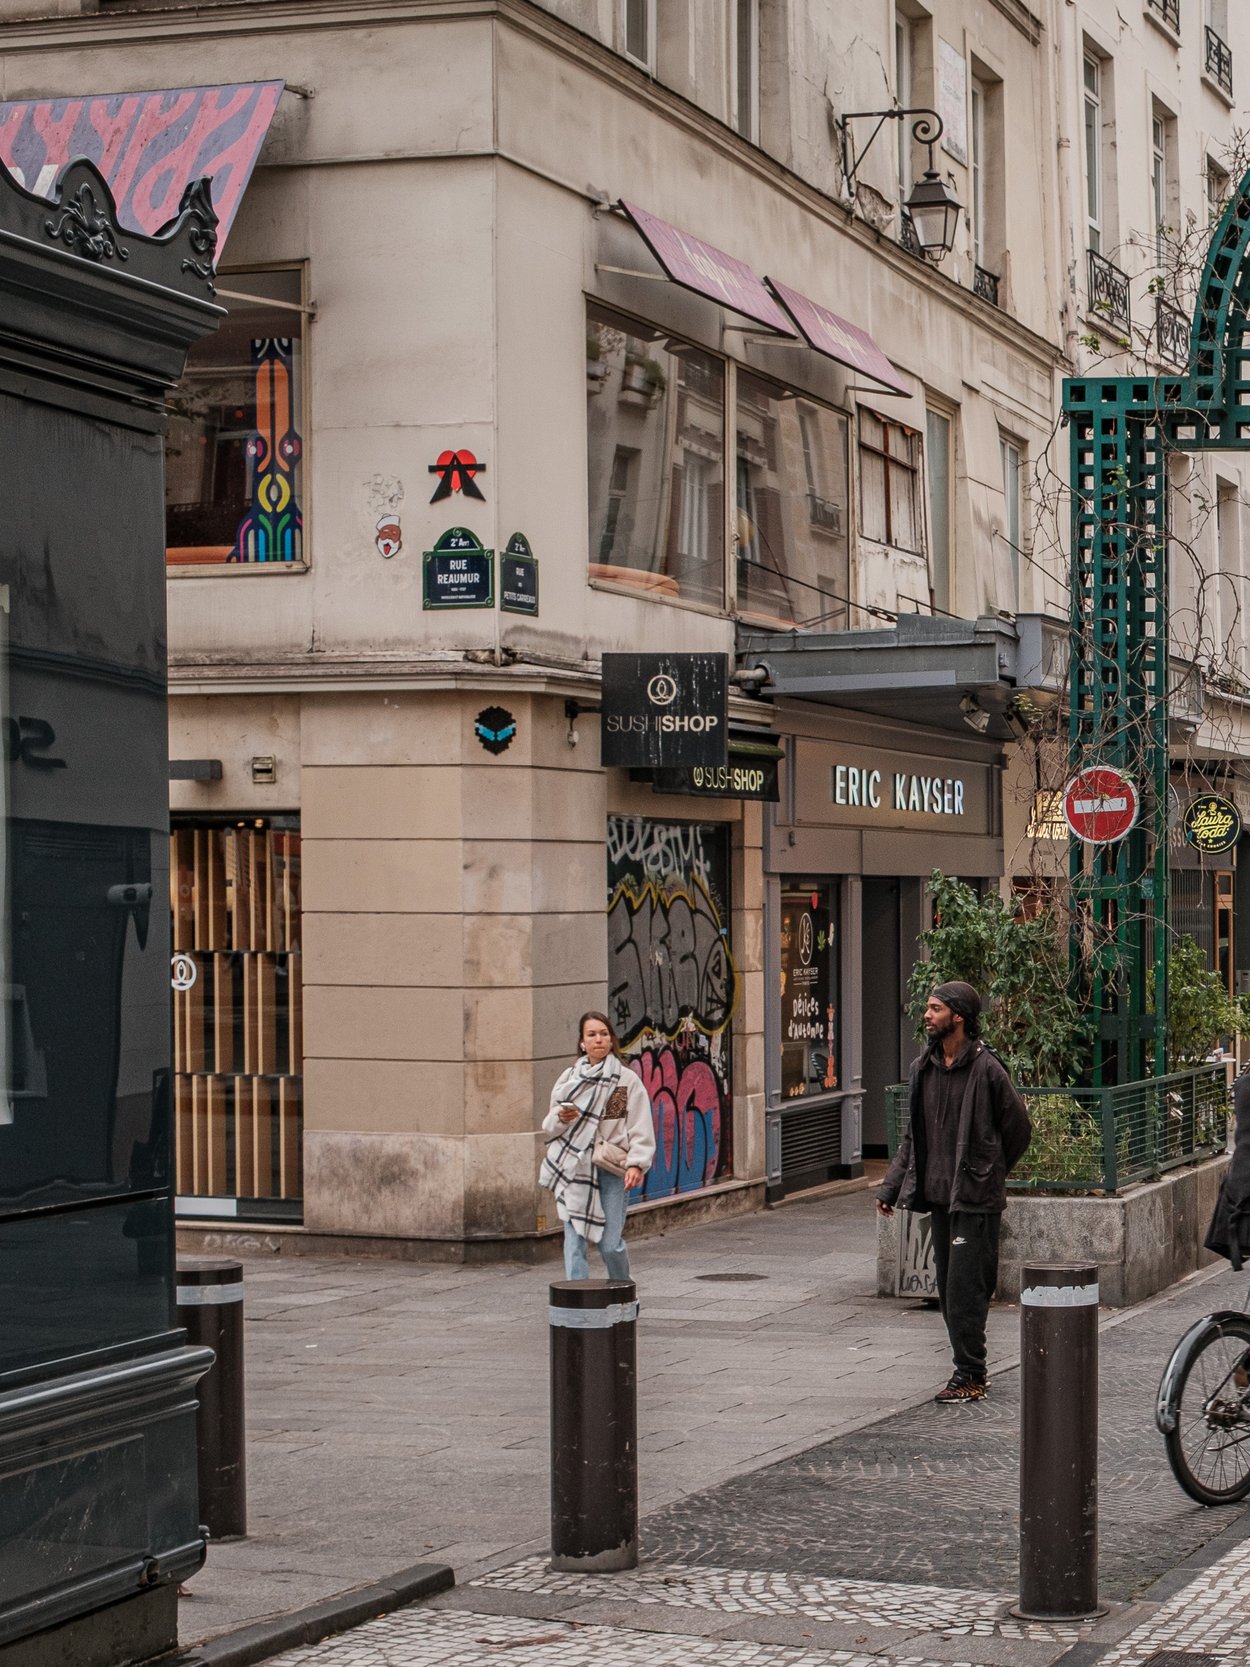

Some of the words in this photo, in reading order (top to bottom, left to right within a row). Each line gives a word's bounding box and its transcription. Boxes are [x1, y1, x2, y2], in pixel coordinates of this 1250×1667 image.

[449, 559, 468, 570] RUE
[437, 573, 480, 584] REAUMUR
[835, 765, 881, 809] ERIC
[895, 772, 964, 815] KAYSER
[1191, 810, 1234, 828] Laura
[1191, 824, 1230, 839] Todd
[792, 992, 819, 1018] Délices
[787, 1019, 824, 1040] d'Automne
